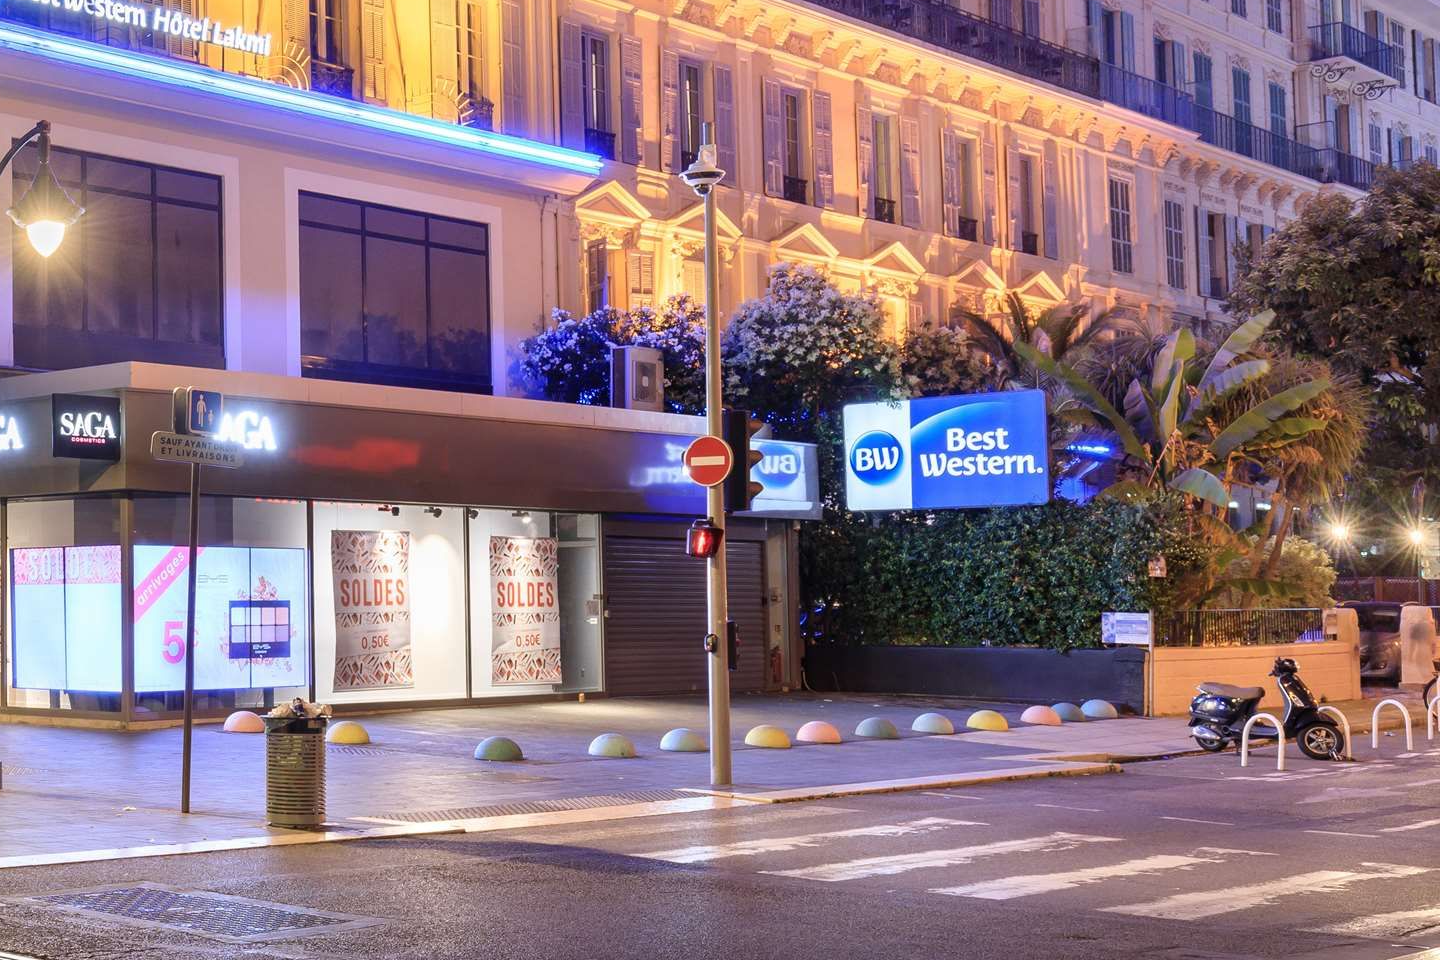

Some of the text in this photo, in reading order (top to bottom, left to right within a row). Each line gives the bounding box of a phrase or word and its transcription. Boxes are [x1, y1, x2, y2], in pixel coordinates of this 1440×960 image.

[153, 6, 210, 42] Hôtel
[213, 21, 272, 57] Lakmi
[60, 411, 116, 439] SAGA
[215, 411, 278, 451] AGA
[160, 436, 181, 445] SAUF
[184, 439, 212, 450] AYANT
[946, 427, 1010, 452] Best
[161, 447, 236, 462] ET LIVRAISONS
[855, 446, 899, 472] BW
[919, 451, 1044, 478] Western.
[137, 551, 186, 606] arrivages
[340, 578, 405, 607] SOLDES
[497, 581, 554, 608] SOLDES
[361, 634, 389, 653] 0,50€
[515, 633, 541, 648] 0,50€
